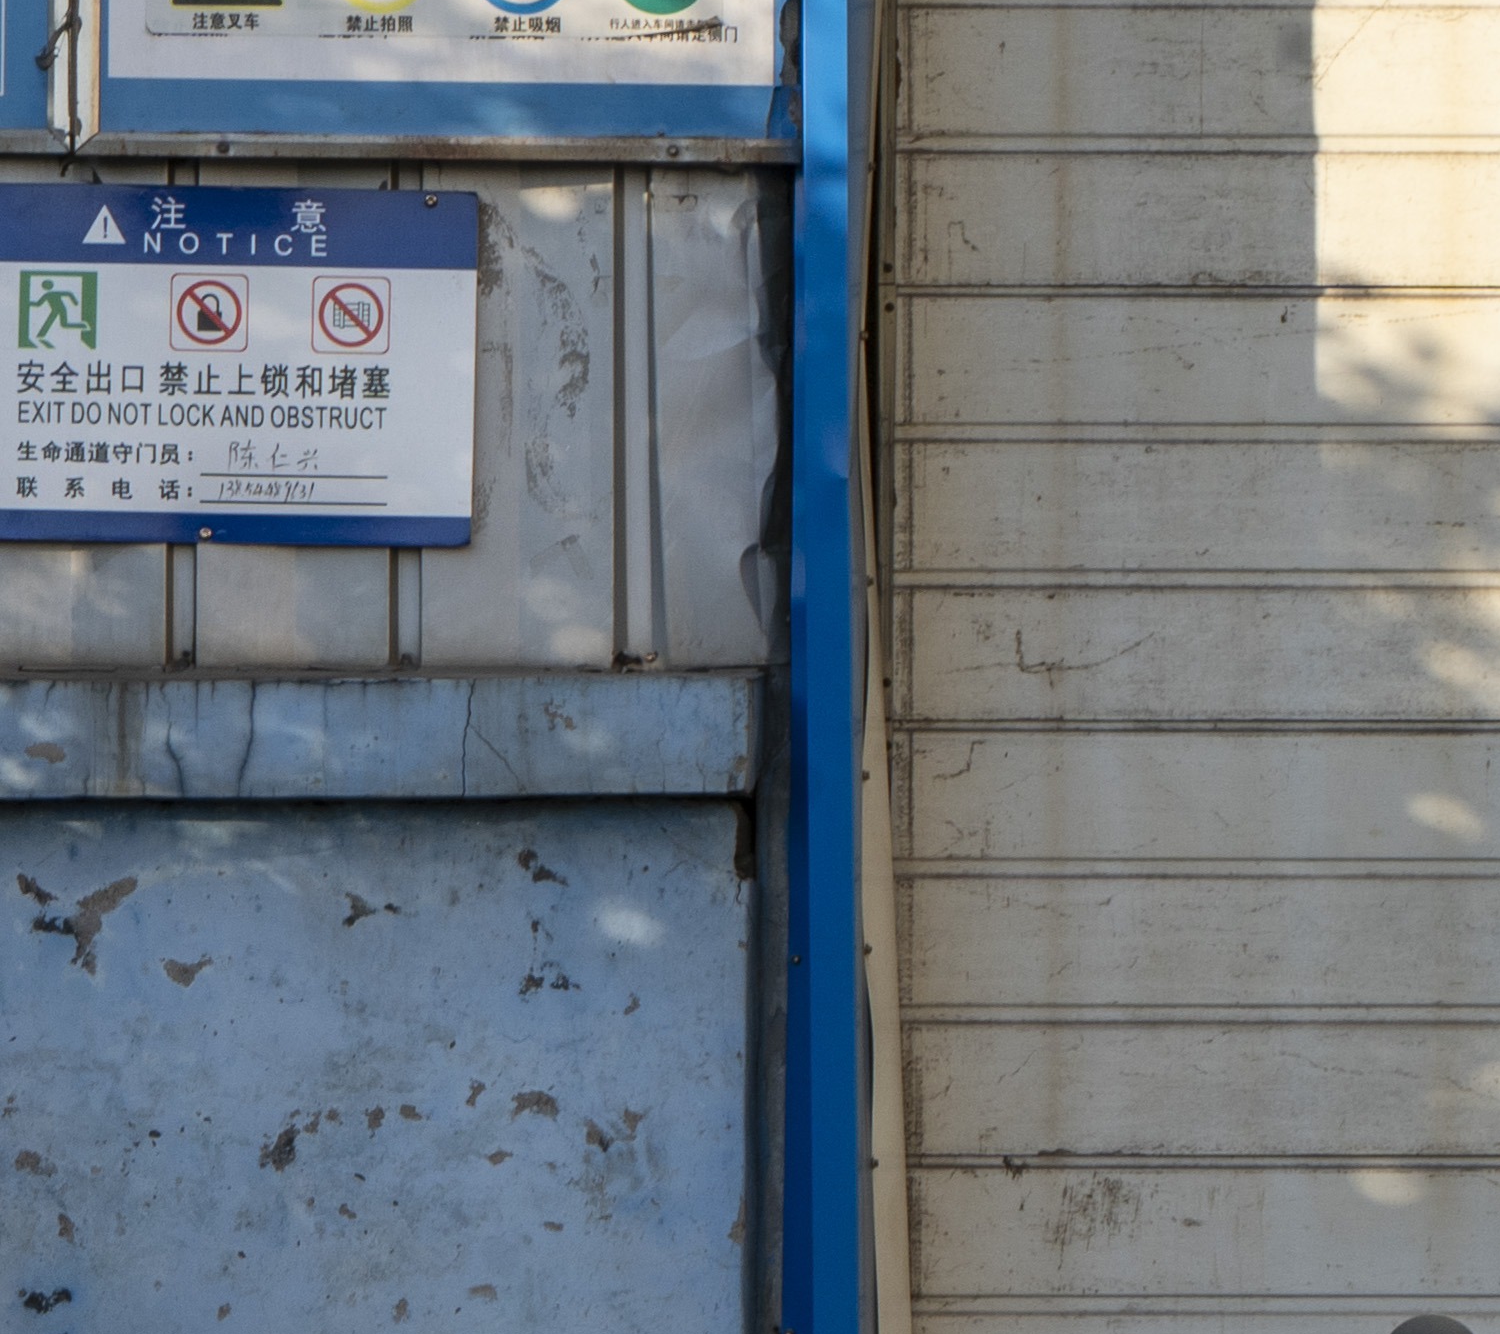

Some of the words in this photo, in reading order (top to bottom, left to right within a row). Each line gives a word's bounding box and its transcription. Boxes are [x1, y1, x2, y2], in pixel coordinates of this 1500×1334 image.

[191, 12, 260, 31] 注意叉车
[346, 15, 414, 33] 禁止拍照
[493, 15, 562, 34] 禁止吸烟
[143, 231, 328, 257] NOTICE
[16, 359, 144, 395] 安全出口
[159, 361, 390, 399] 禁止上锁和堵塞
[17, 400, 65, 424] EXIT
[71, 401, 102, 425] DO
[107, 402, 152, 426] NOT
[158, 403, 215, 427] LOCK
[220, 404, 265, 428] AND
[270, 404, 388, 430] OBSTRUCT
